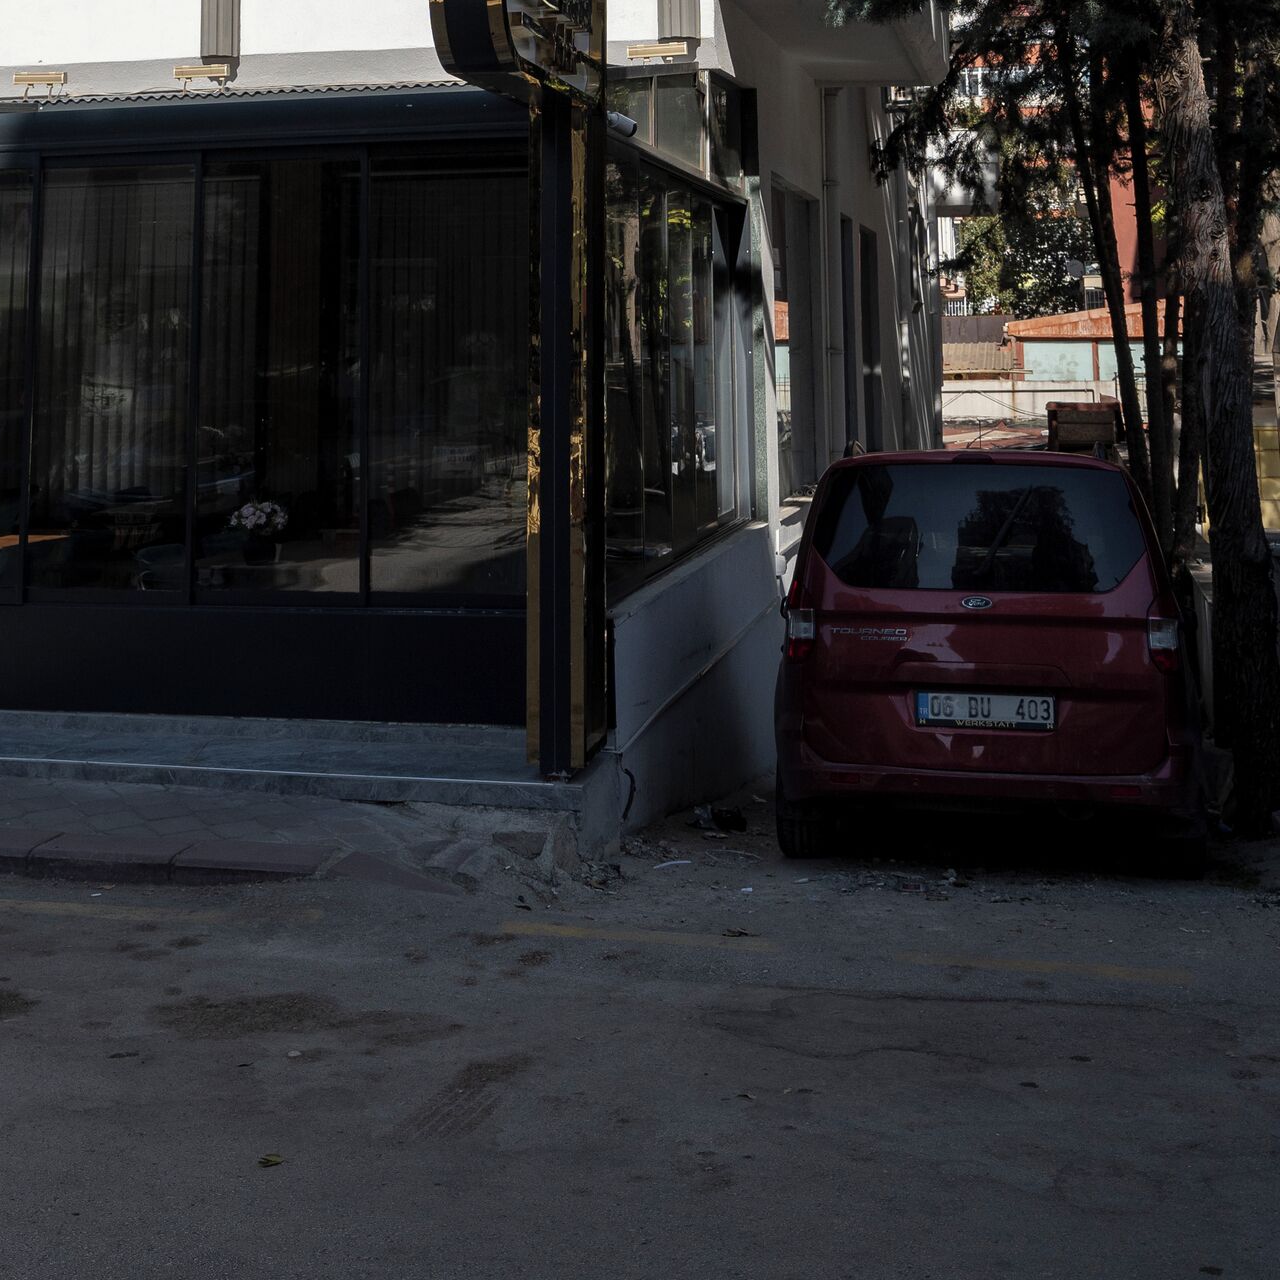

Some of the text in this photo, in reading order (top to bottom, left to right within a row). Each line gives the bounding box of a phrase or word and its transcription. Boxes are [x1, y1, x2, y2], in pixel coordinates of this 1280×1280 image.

[831, 627, 907, 635] TOURNEO
[930, 695, 954, 718] 06
[1015, 698, 1052, 721] 403
[955, 719, 1018, 729] WERKSTATT
